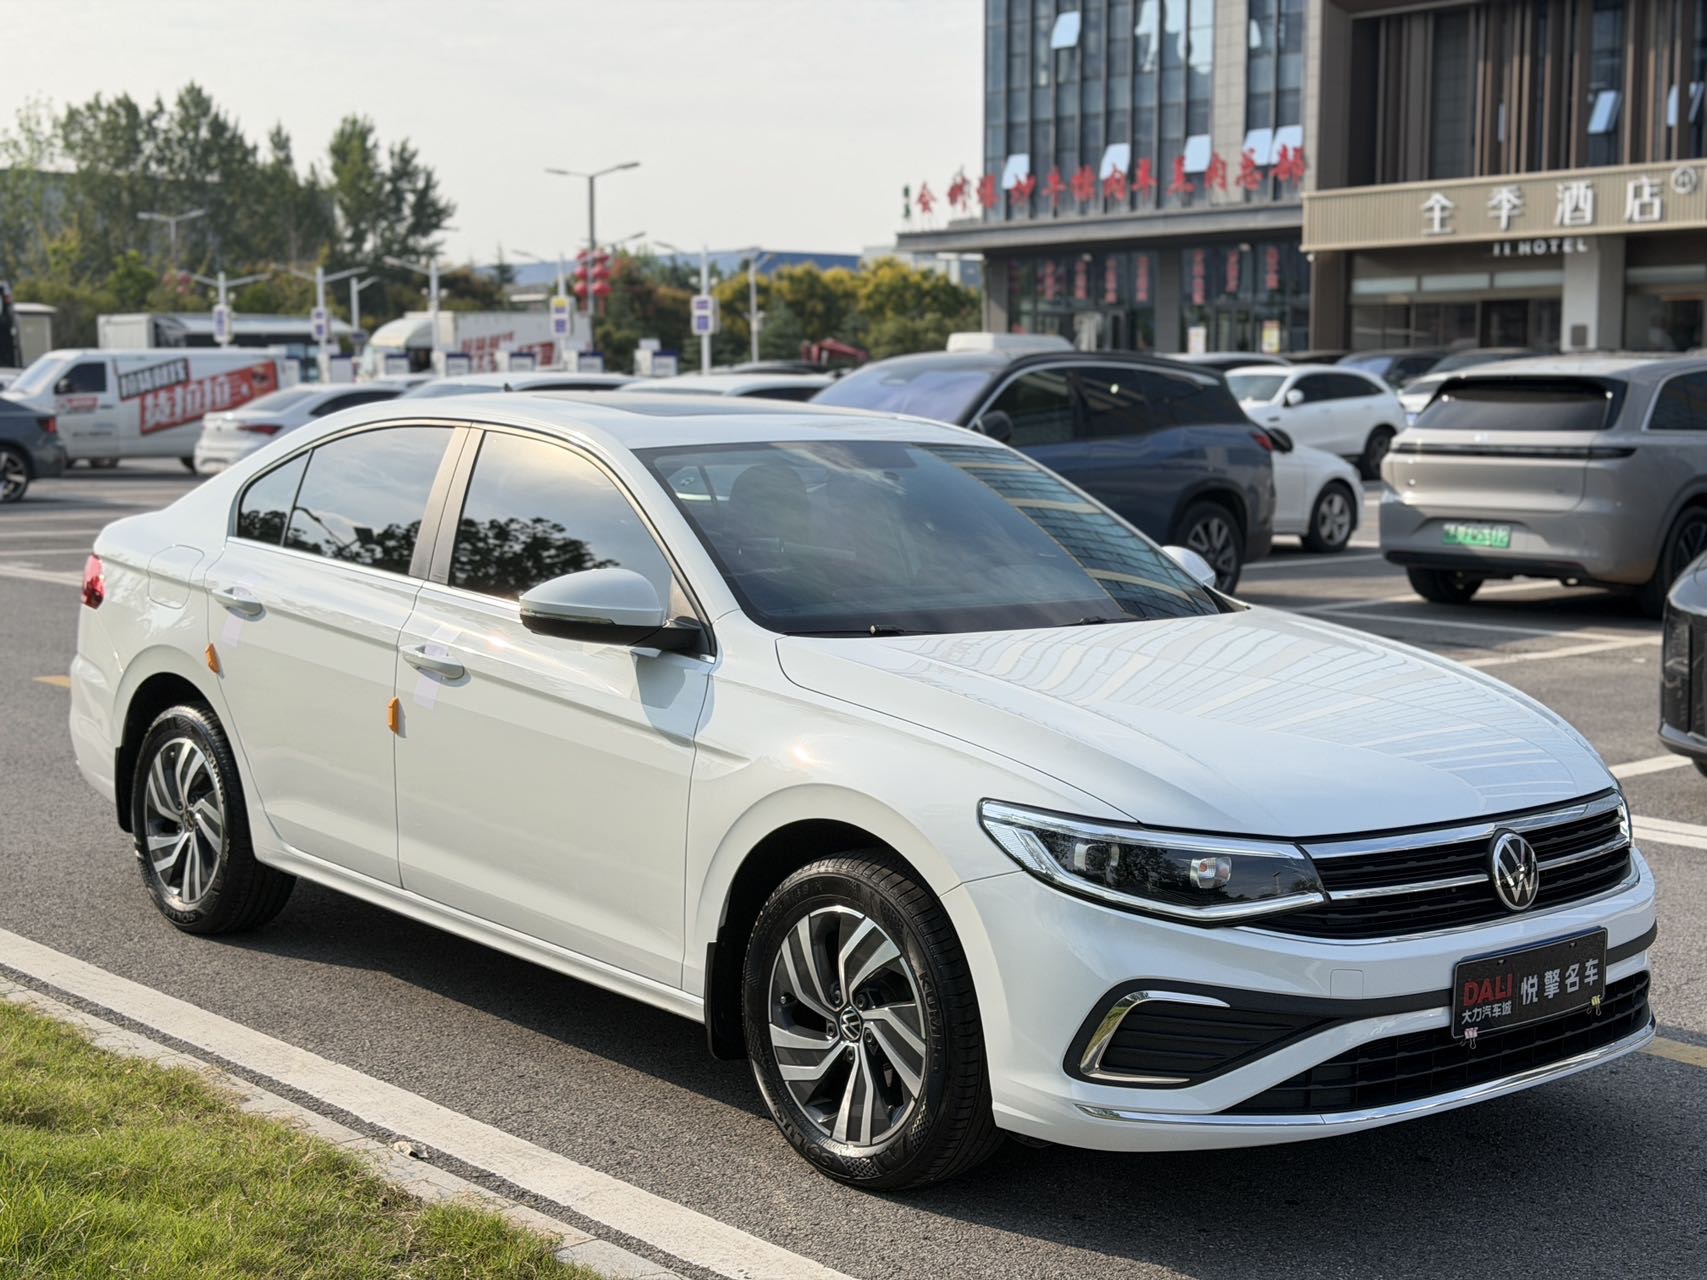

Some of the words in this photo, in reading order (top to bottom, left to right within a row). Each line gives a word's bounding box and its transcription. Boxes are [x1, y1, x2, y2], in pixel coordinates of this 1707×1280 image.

[1421, 175, 1665, 235] 全季酒店
[1517, 237, 1588, 255] HOTEL
[1463, 973, 1513, 1007] DALI
[1520, 958, 1599, 1005] 悦擎名车
[1461, 1000, 1513, 1025] 大力汽车城
